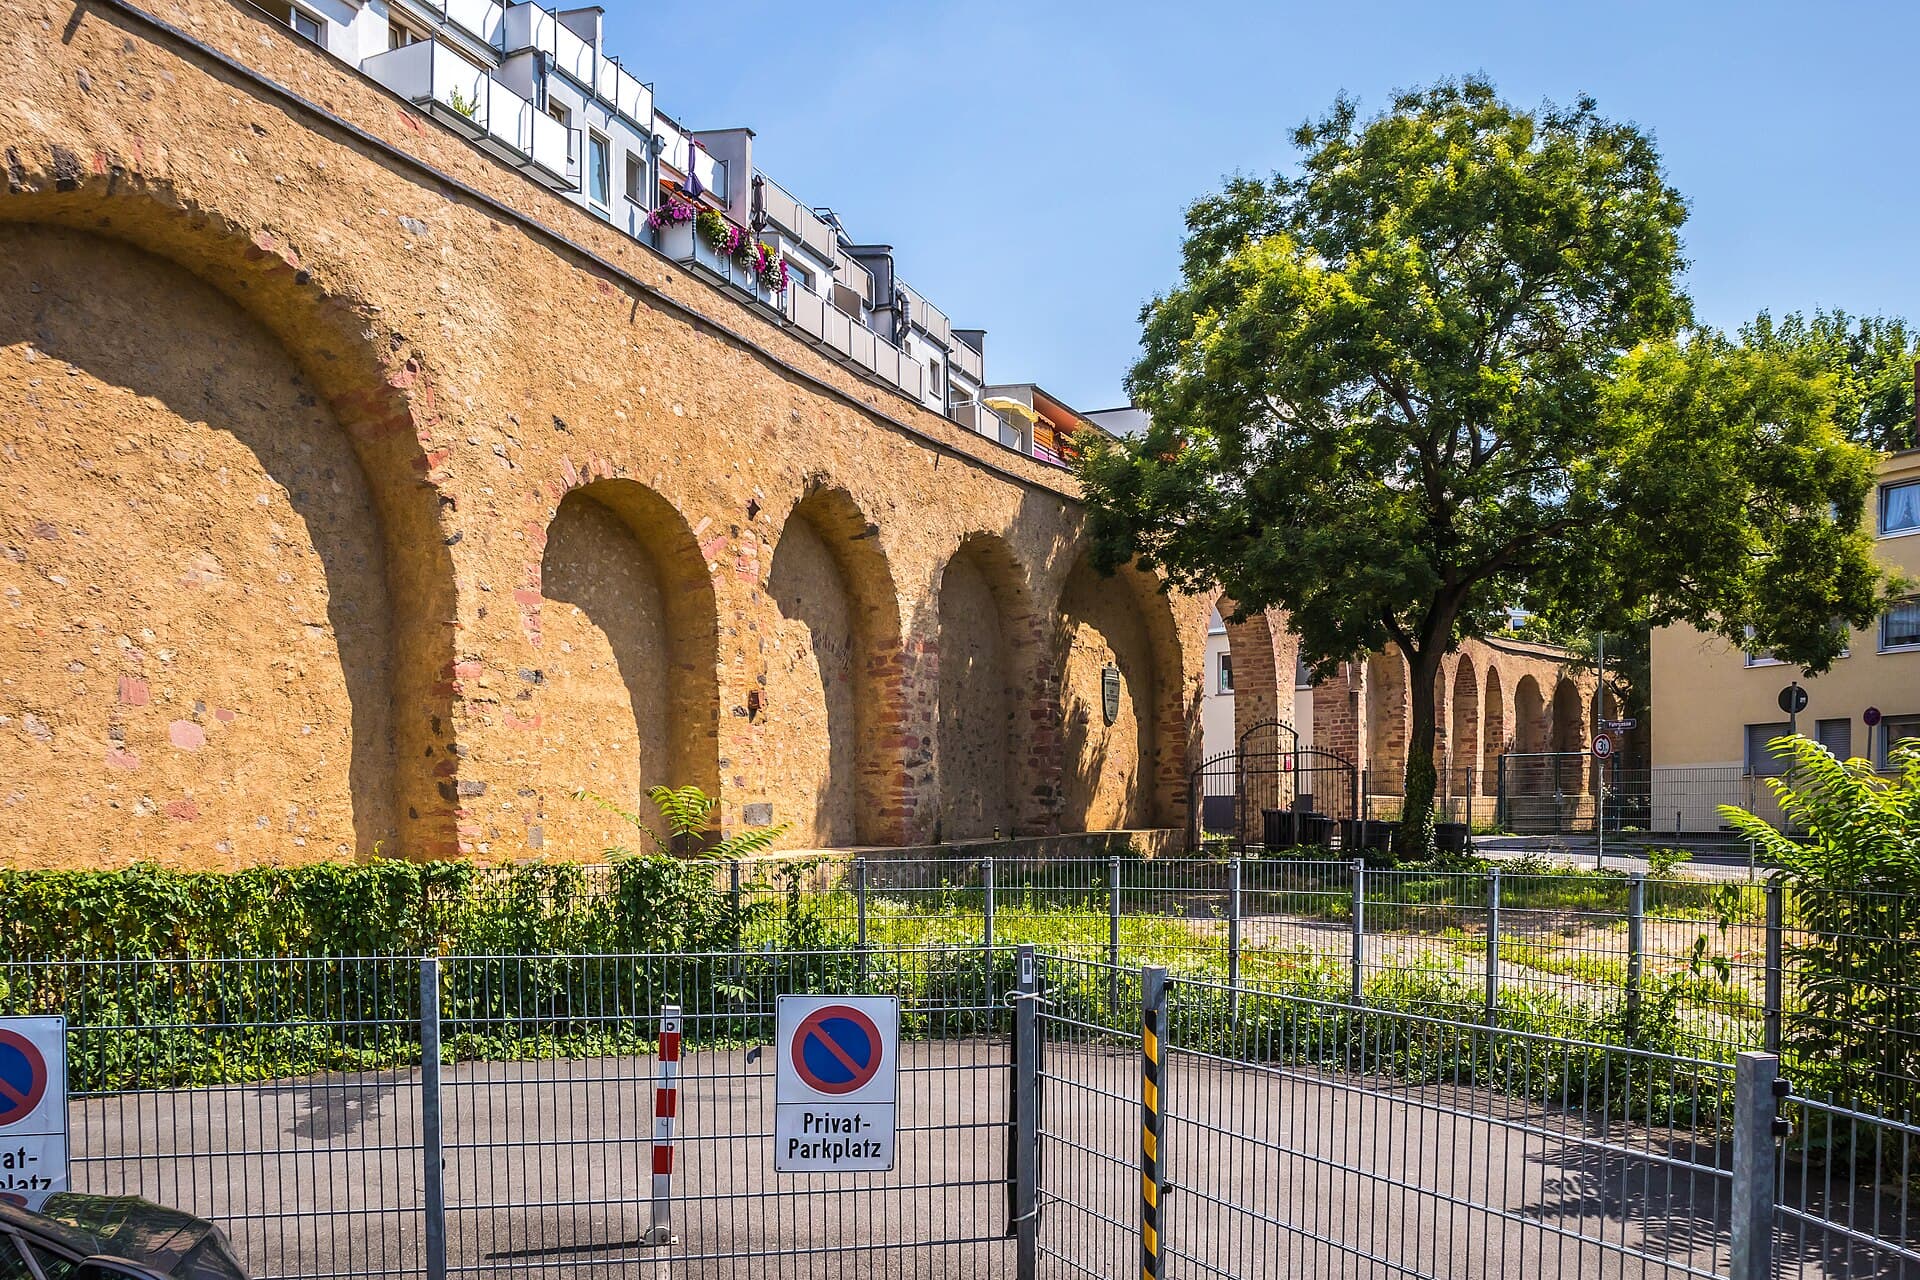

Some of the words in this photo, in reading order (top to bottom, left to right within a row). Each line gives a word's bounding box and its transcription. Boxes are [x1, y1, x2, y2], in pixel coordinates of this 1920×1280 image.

[803, 1112, 871, 1134] Privat-
[0, 1146, 38, 1169] at-
[788, 1137, 881, 1164] Parkplatz
